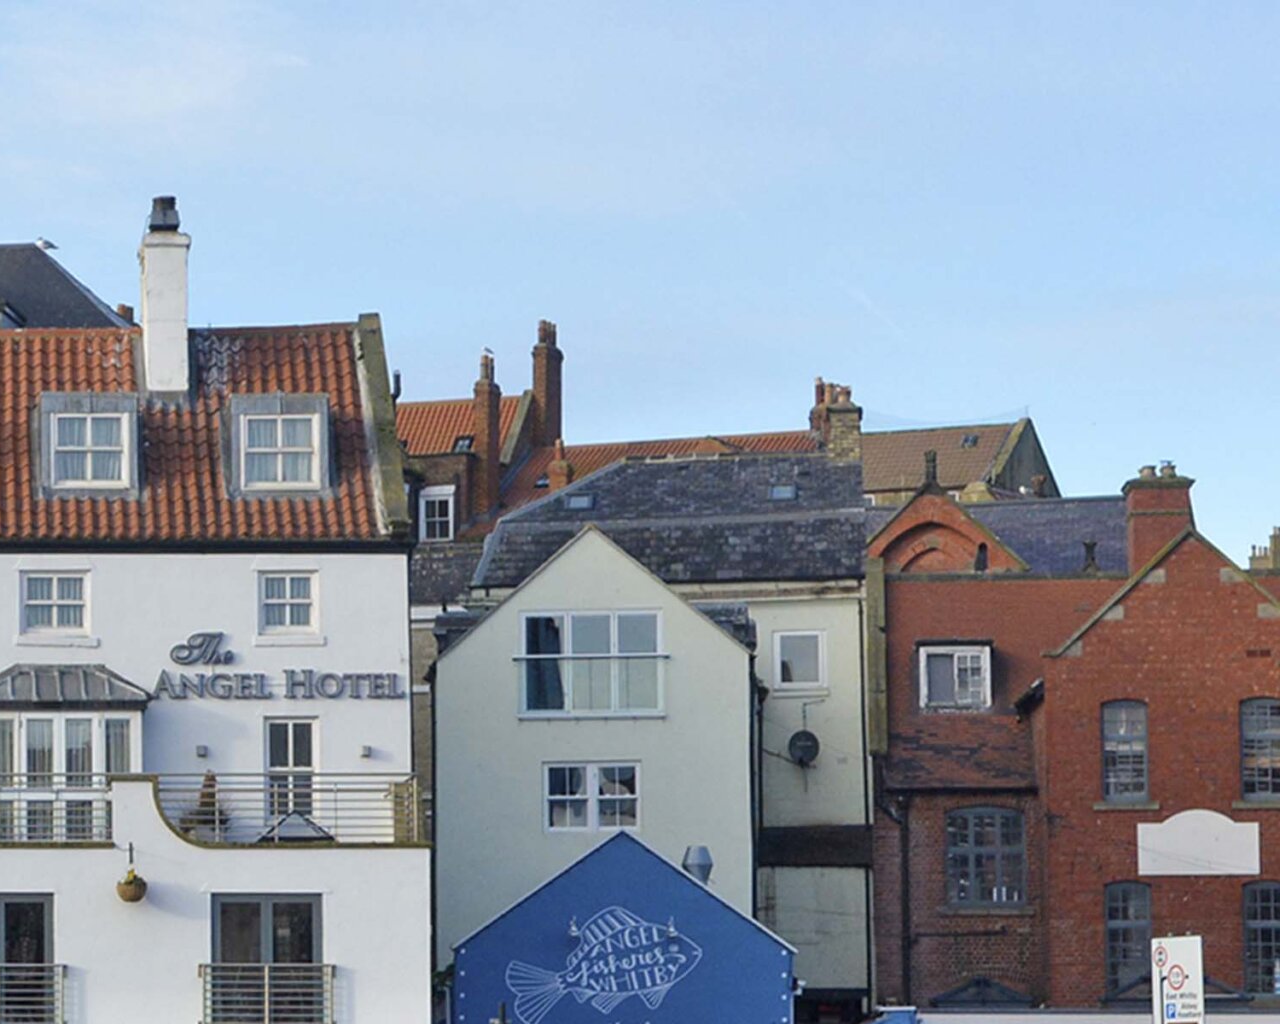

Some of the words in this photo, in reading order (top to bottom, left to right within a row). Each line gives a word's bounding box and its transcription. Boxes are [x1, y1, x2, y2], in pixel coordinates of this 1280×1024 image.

[170, 632, 235, 666] The
[153, 669, 273, 700] ANGEL
[283, 669, 407, 700] HOTEL
[589, 925, 666, 957] ANGEL
[590, 963, 681, 992] WHITBY
